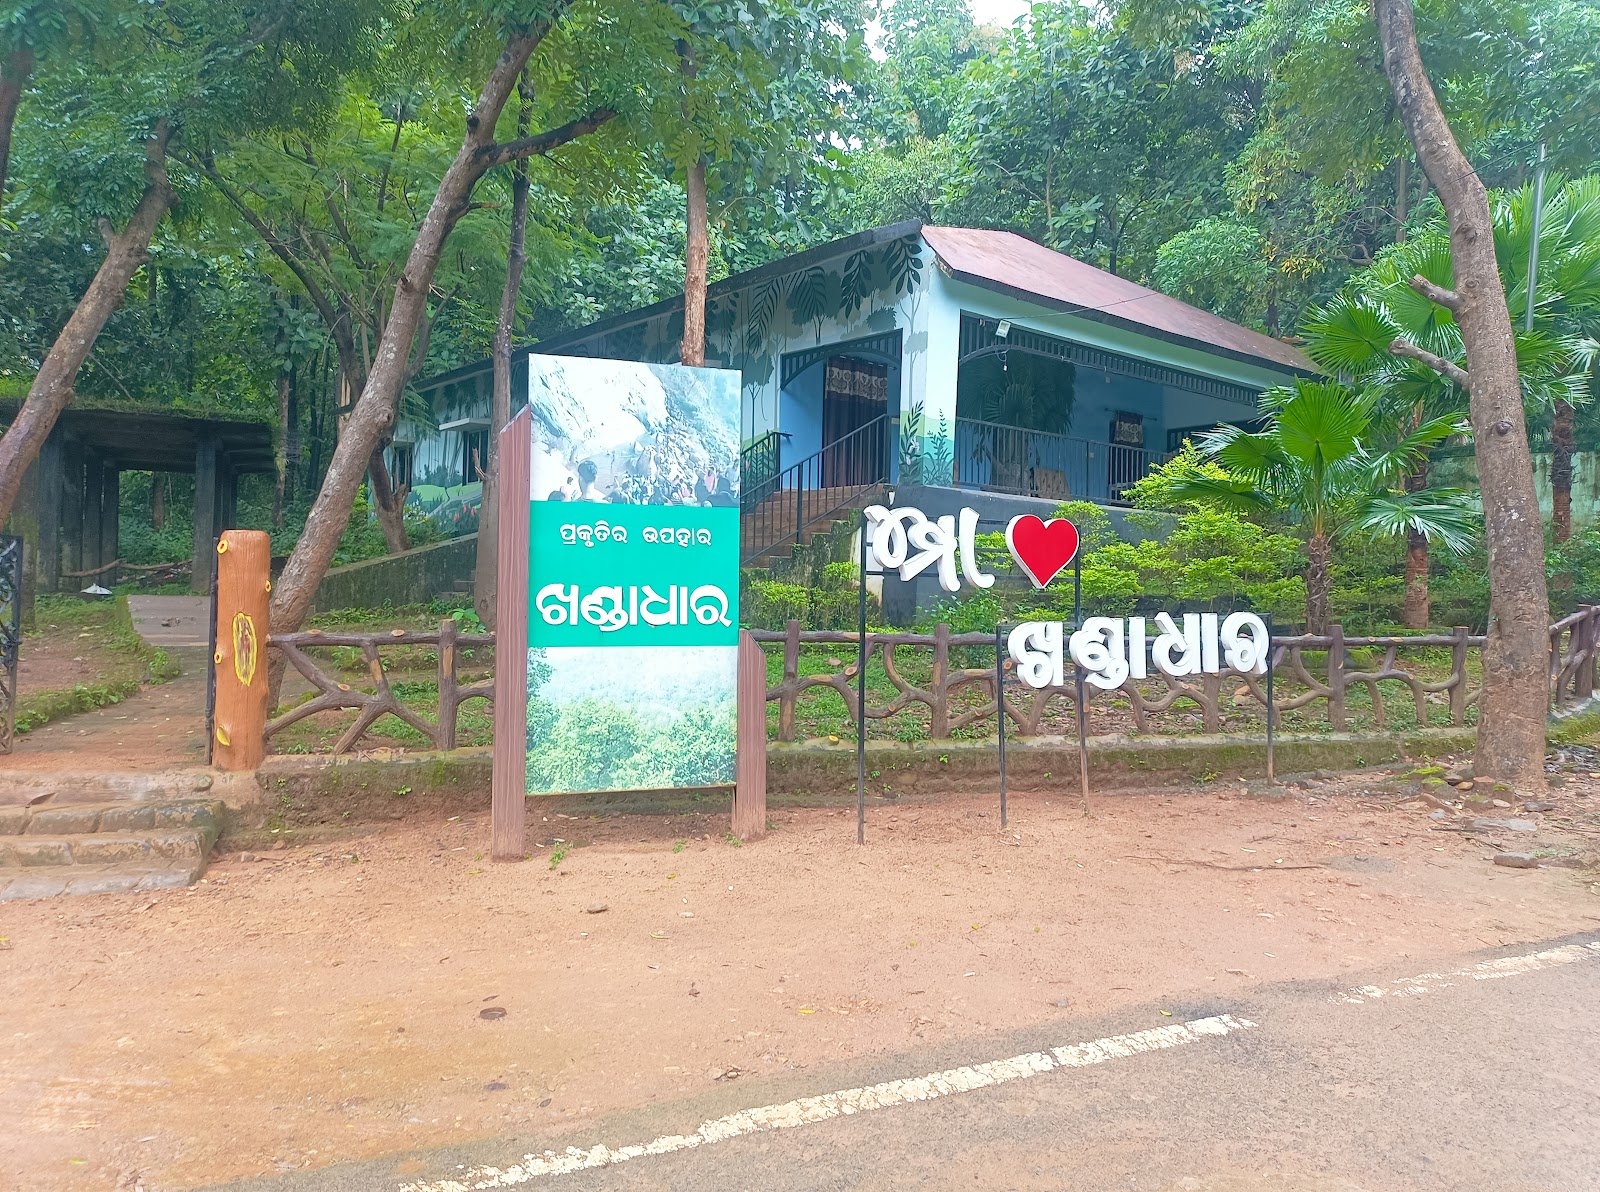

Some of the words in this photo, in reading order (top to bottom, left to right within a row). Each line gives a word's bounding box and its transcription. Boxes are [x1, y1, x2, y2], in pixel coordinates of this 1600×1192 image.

[560, 520, 628, 548] ପ୍ରକୃତିର
[642, 526, 712, 548] ଉପହାର
[535, 583, 732, 632] ଖଣ୍ଡାଧାର
[1007, 611, 1270, 690] ଖଣ୍ଡାଧାର
